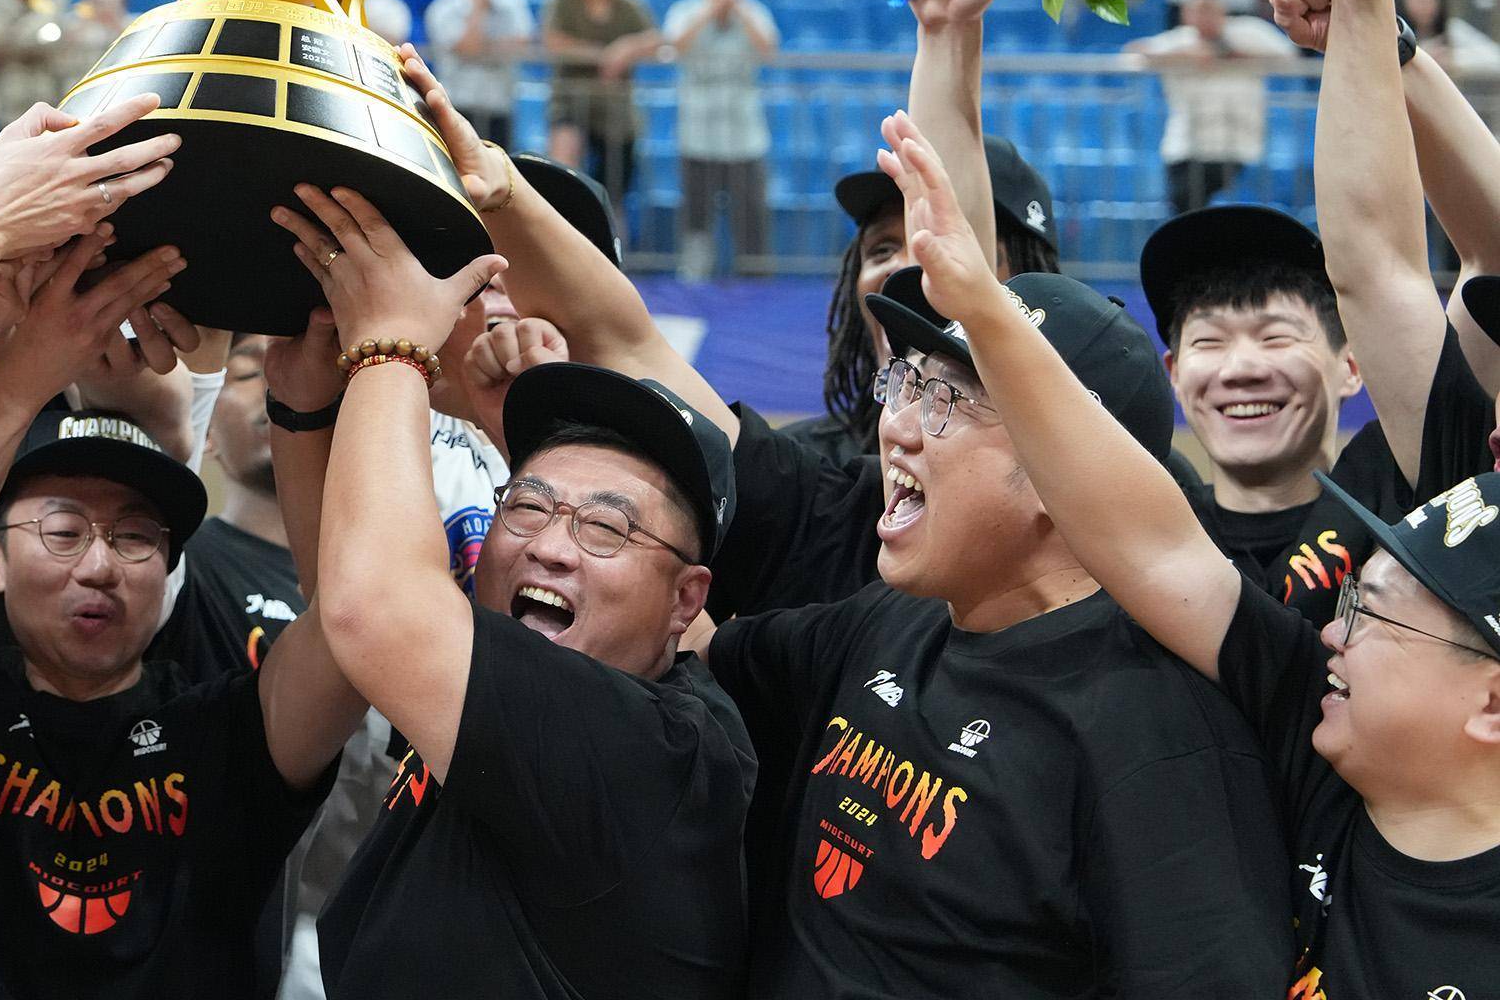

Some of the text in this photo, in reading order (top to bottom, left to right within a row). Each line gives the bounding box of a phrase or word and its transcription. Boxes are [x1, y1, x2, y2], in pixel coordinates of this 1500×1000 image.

[838, 796, 878, 827] 2024
[820, 819, 875, 859] MIDCOURT
[28, 861, 143, 894] MIDCOURT
[54, 852, 108, 873] 2024
